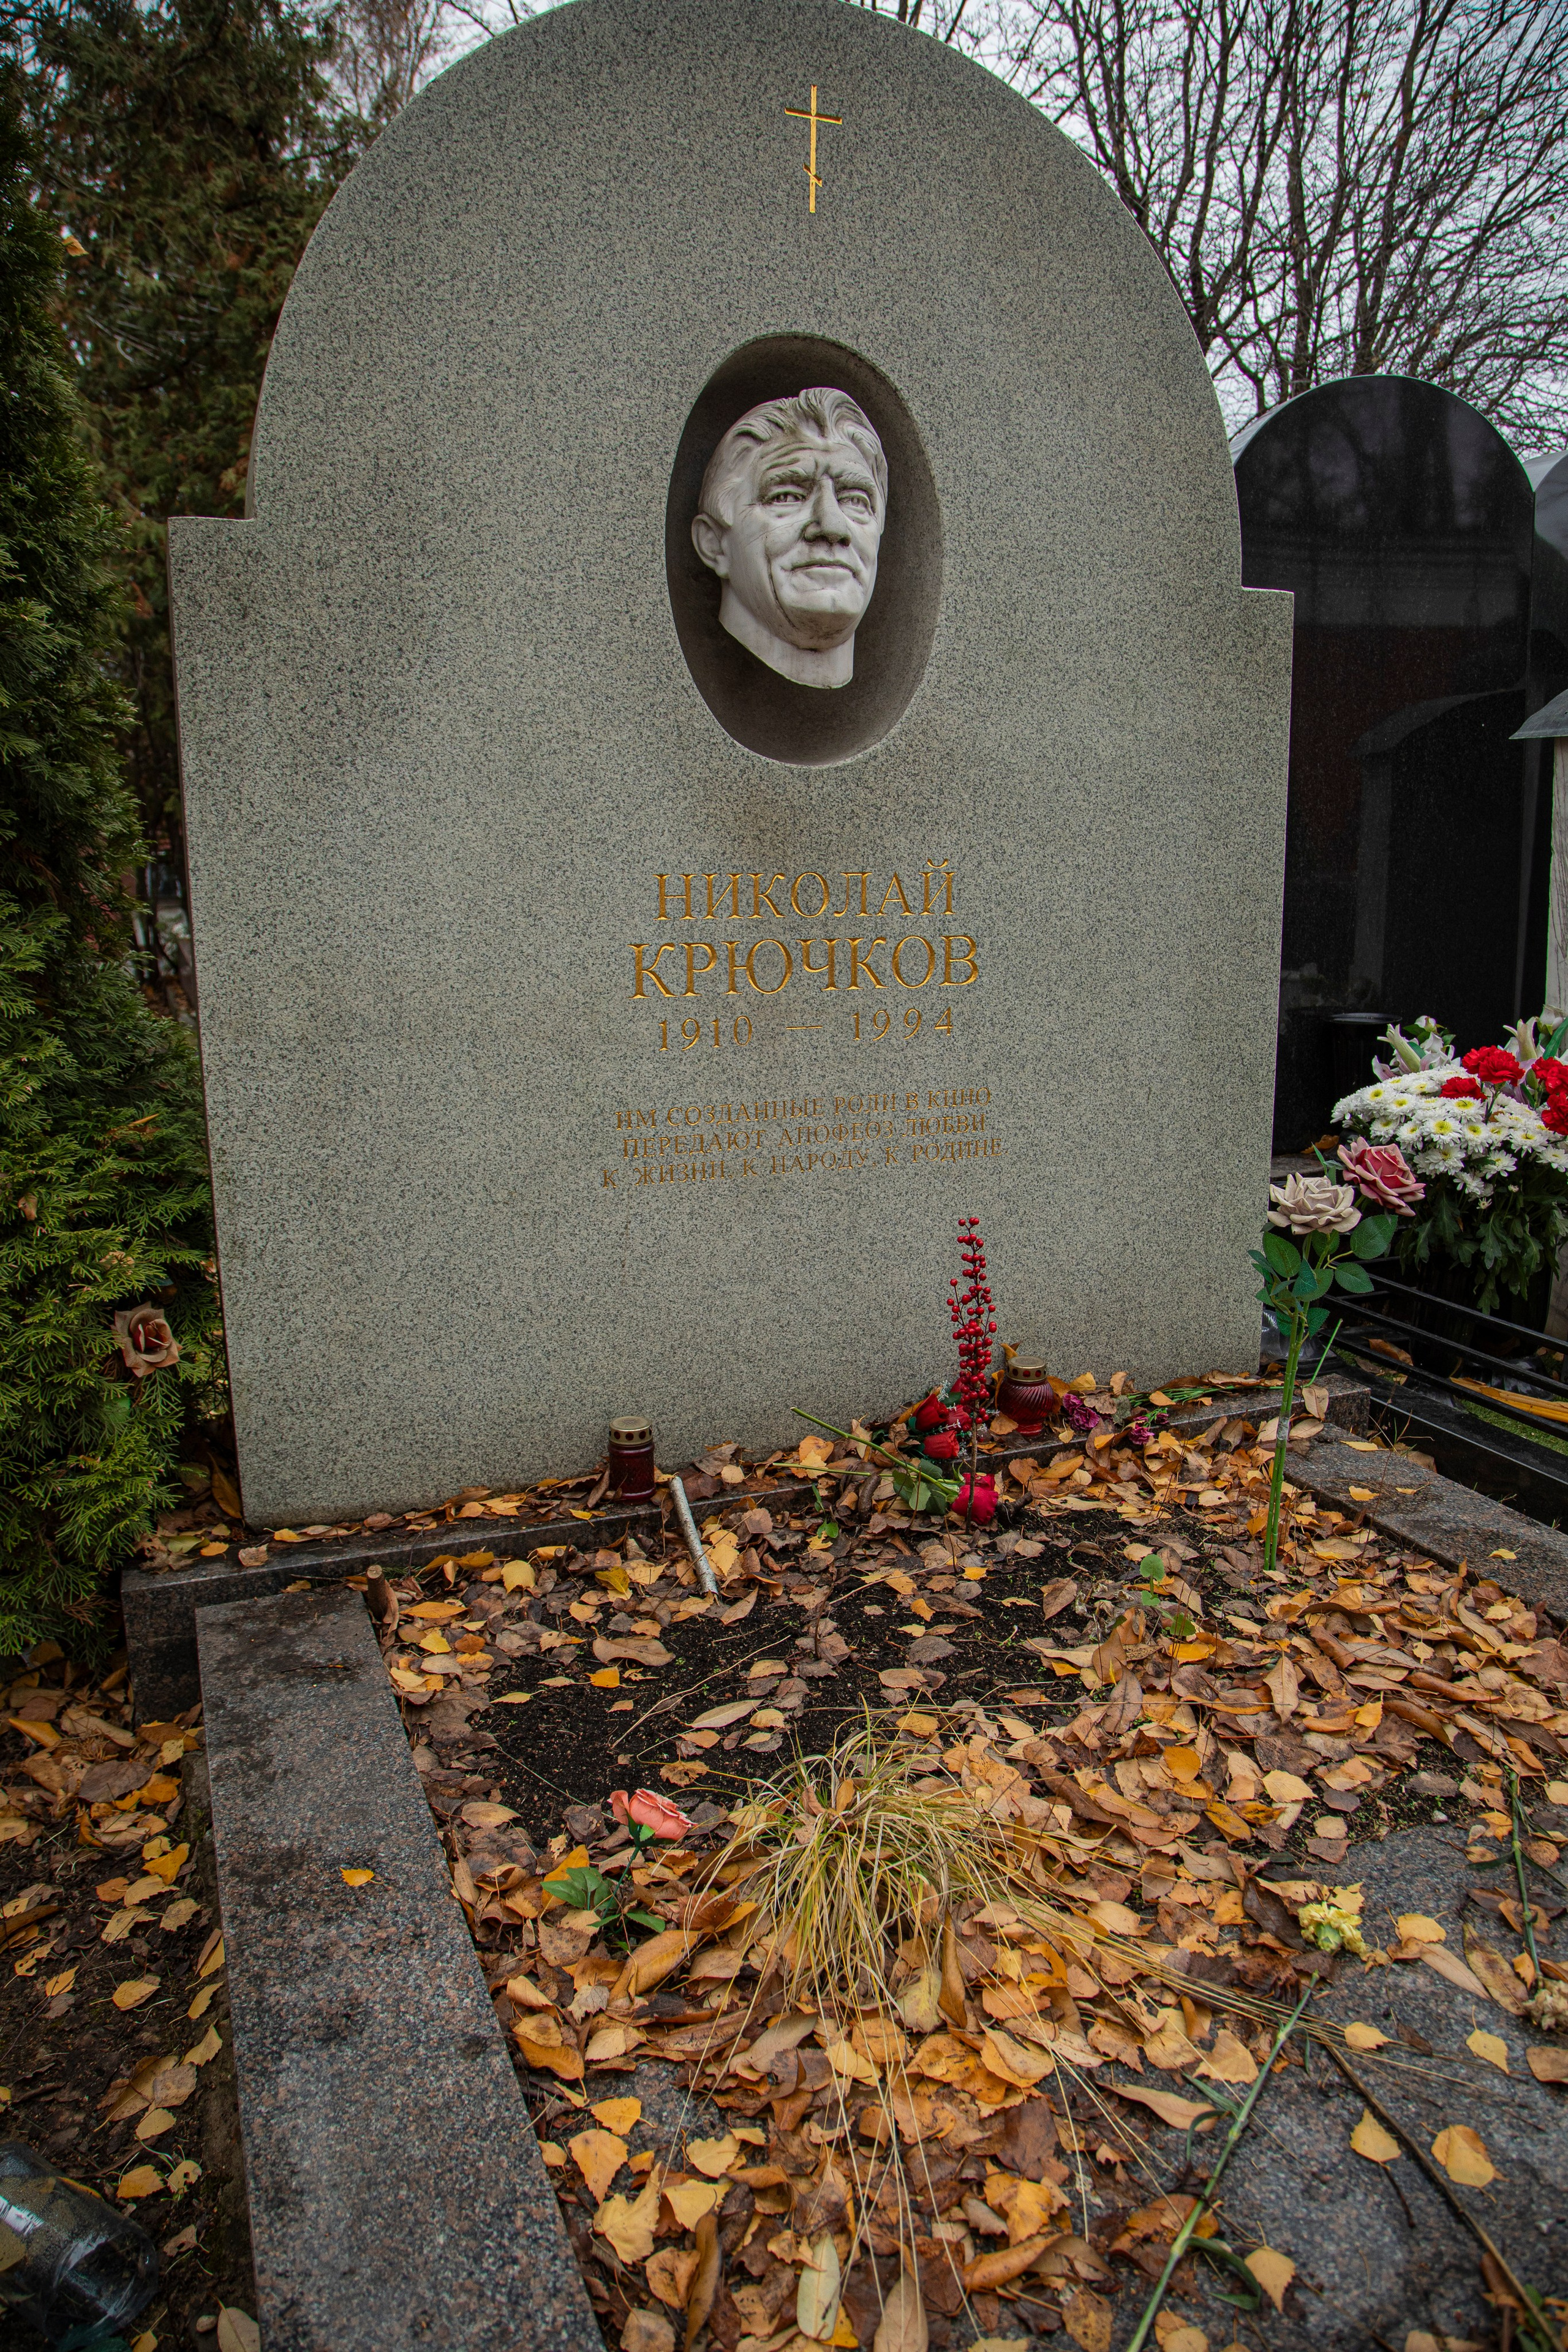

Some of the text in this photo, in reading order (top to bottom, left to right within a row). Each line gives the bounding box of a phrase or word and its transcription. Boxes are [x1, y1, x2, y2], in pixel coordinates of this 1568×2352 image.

[653, 858, 956, 921] НИКОЛАЙ
[627, 935, 979, 1000] КРЮЧКОВ
[658, 1015, 753, 1051] 1910
[851, 1006, 955, 1041] 1994
[615, 1087, 991, 1130] ИМ СОЗДАННЫЕ РОЛИ В КИНО
[622, 1114, 986, 1159] ПЕРЕДАЮТ АПОФЕОЗ ЛЮБВИ
[602, 1169, 619, 1188] К
[741, 1158, 758, 1177] К
[771, 1148, 876, 1174] НАРОДУ,
[884, 1146, 900, 1165] К
[911, 1138, 1009, 1164] РОДИНЕ.
